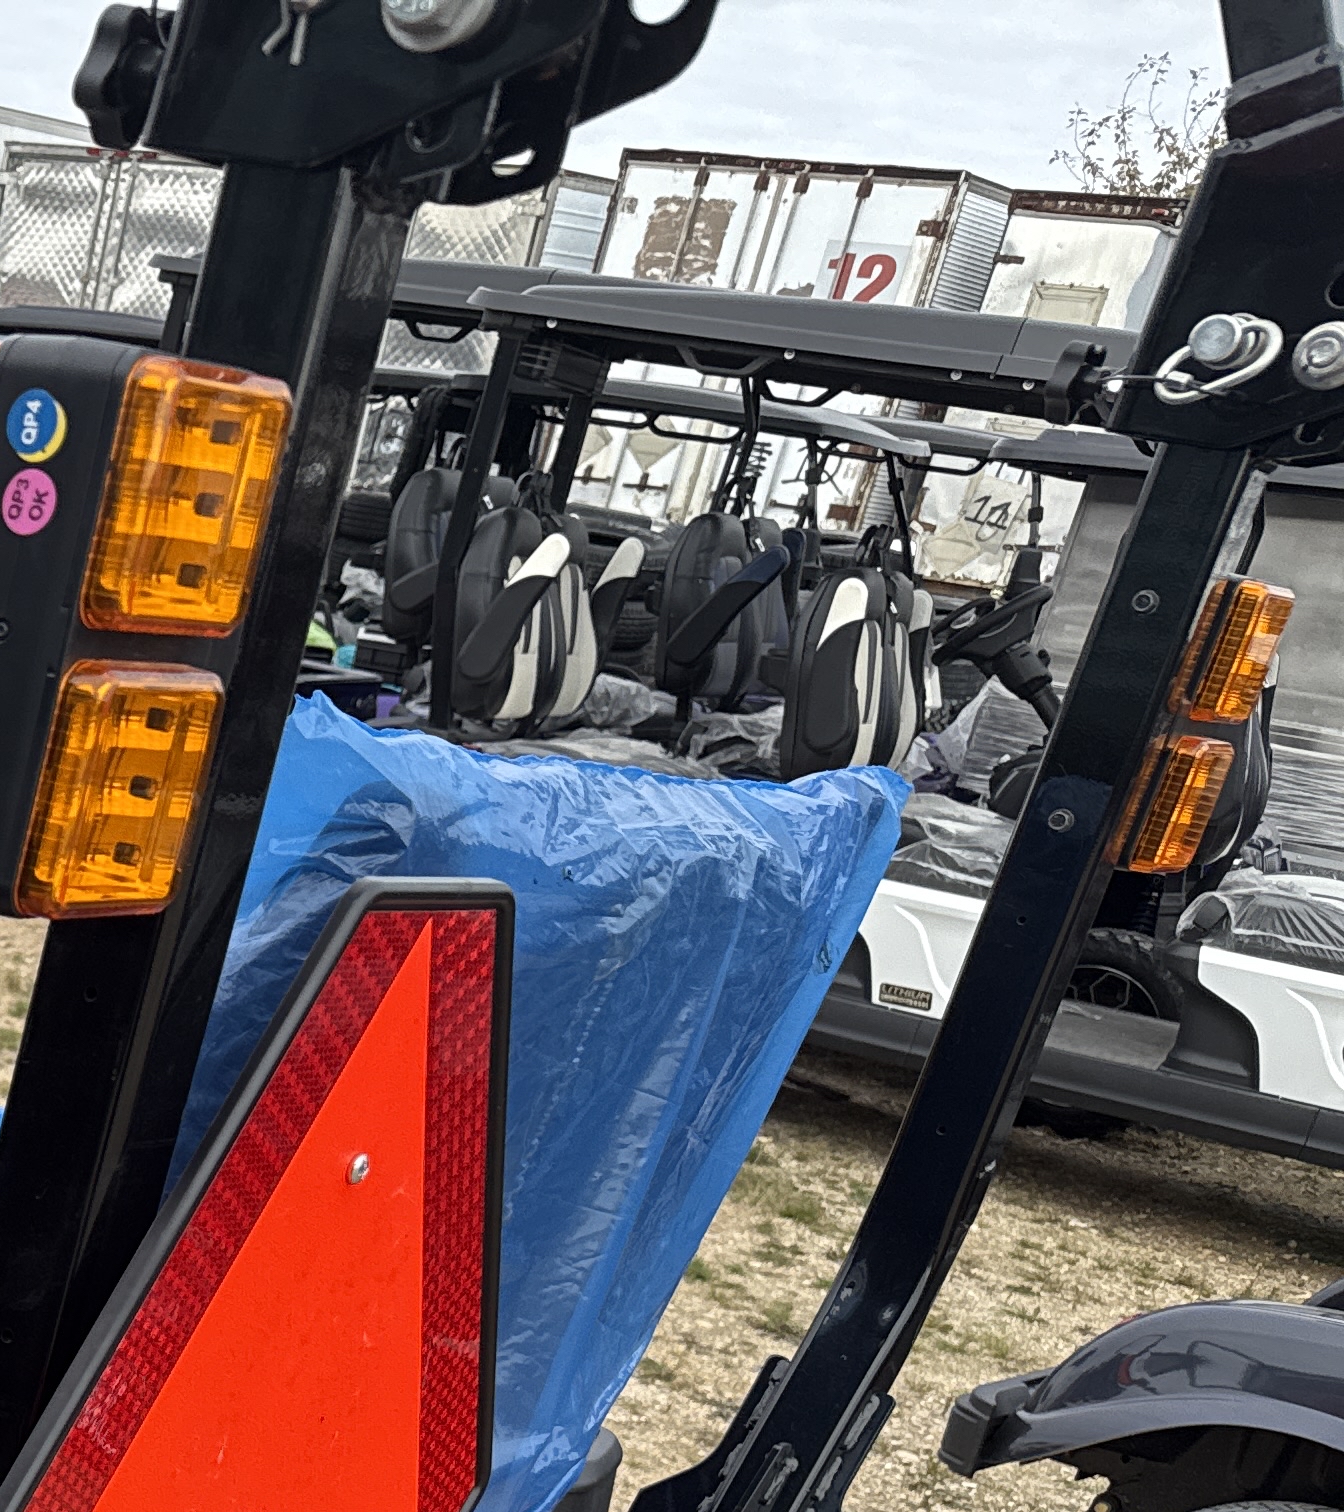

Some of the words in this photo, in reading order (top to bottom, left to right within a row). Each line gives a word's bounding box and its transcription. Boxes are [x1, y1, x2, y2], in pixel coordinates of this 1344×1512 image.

[827, 252, 897, 303] 12
[21, 399, 42, 445] QP4
[7, 478, 29, 520] QP3
[28, 488, 49, 521] OK
